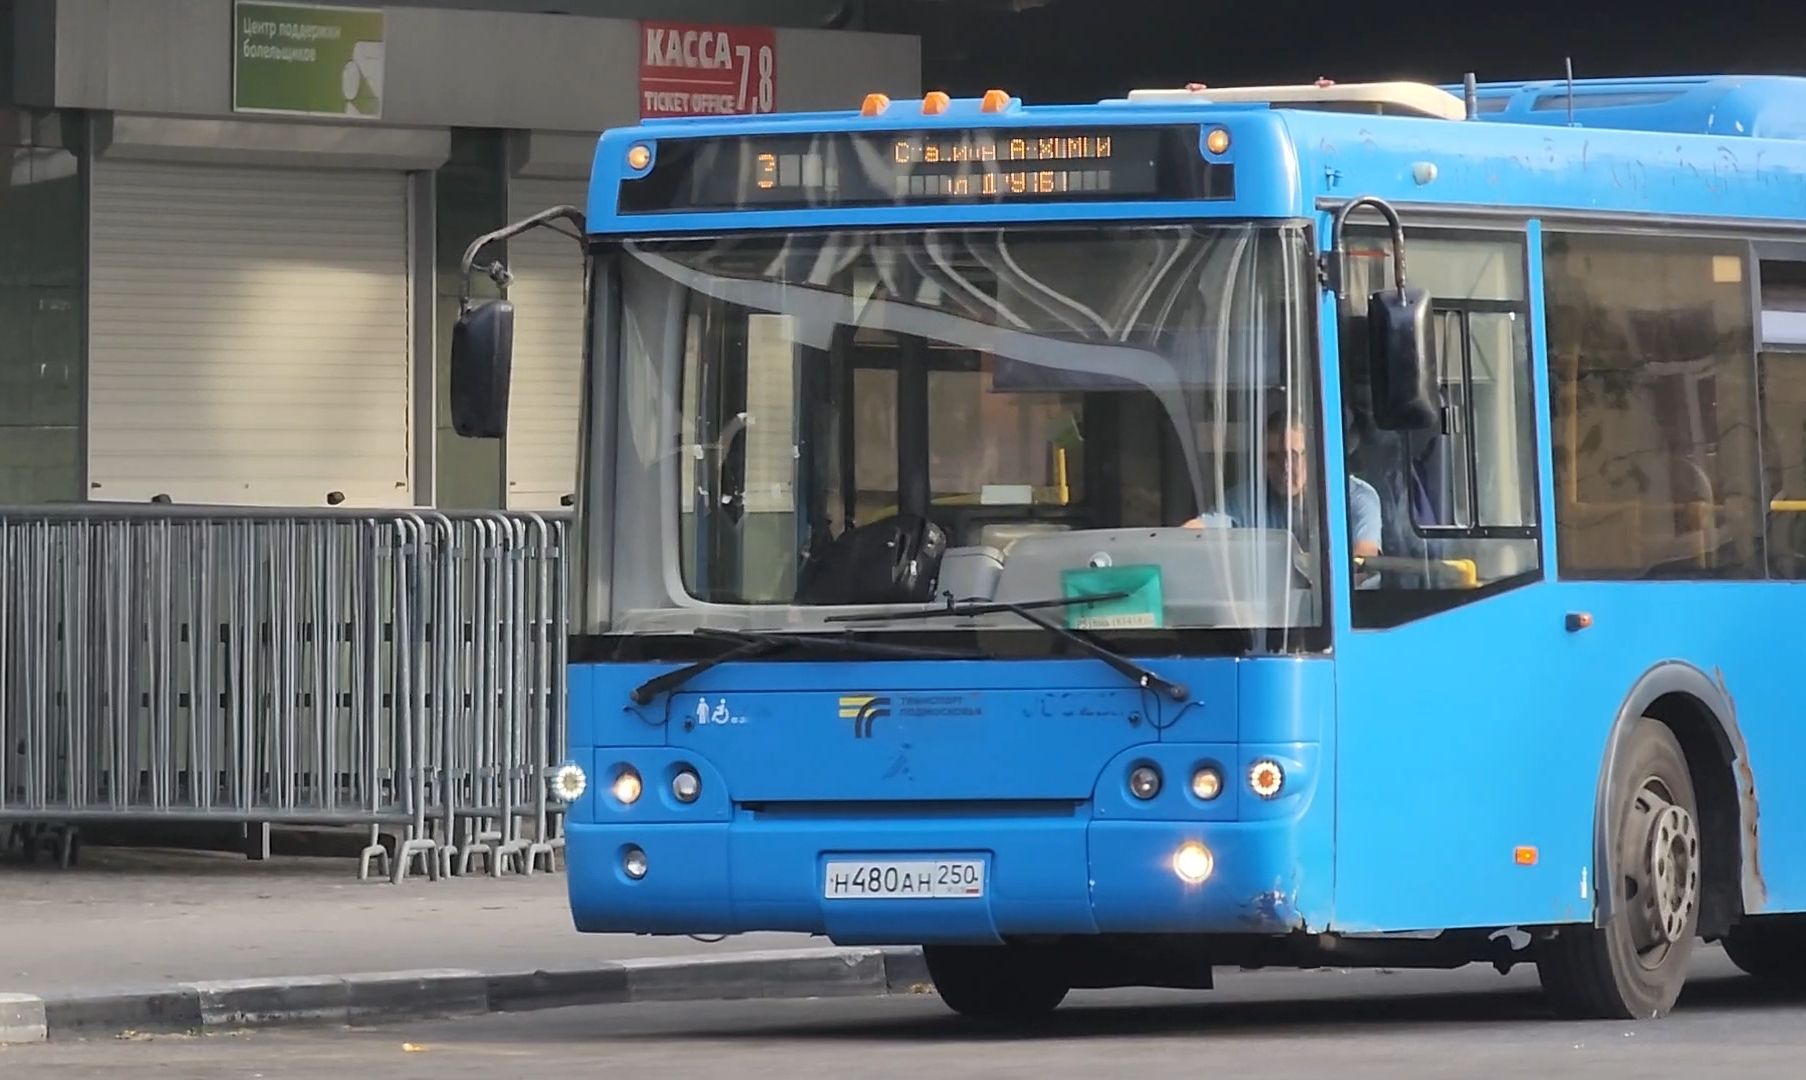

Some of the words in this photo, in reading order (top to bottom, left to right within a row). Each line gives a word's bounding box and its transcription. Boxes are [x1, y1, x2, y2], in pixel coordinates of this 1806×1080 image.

[243, 16, 277, 39] Центр
[647, 28, 733, 70] КАССА
[735, 44, 774, 114] 7,8
[644, 91, 690, 112] TICKET
[691, 93, 735, 114] OFFICE
[938, 865, 975, 884] 250
